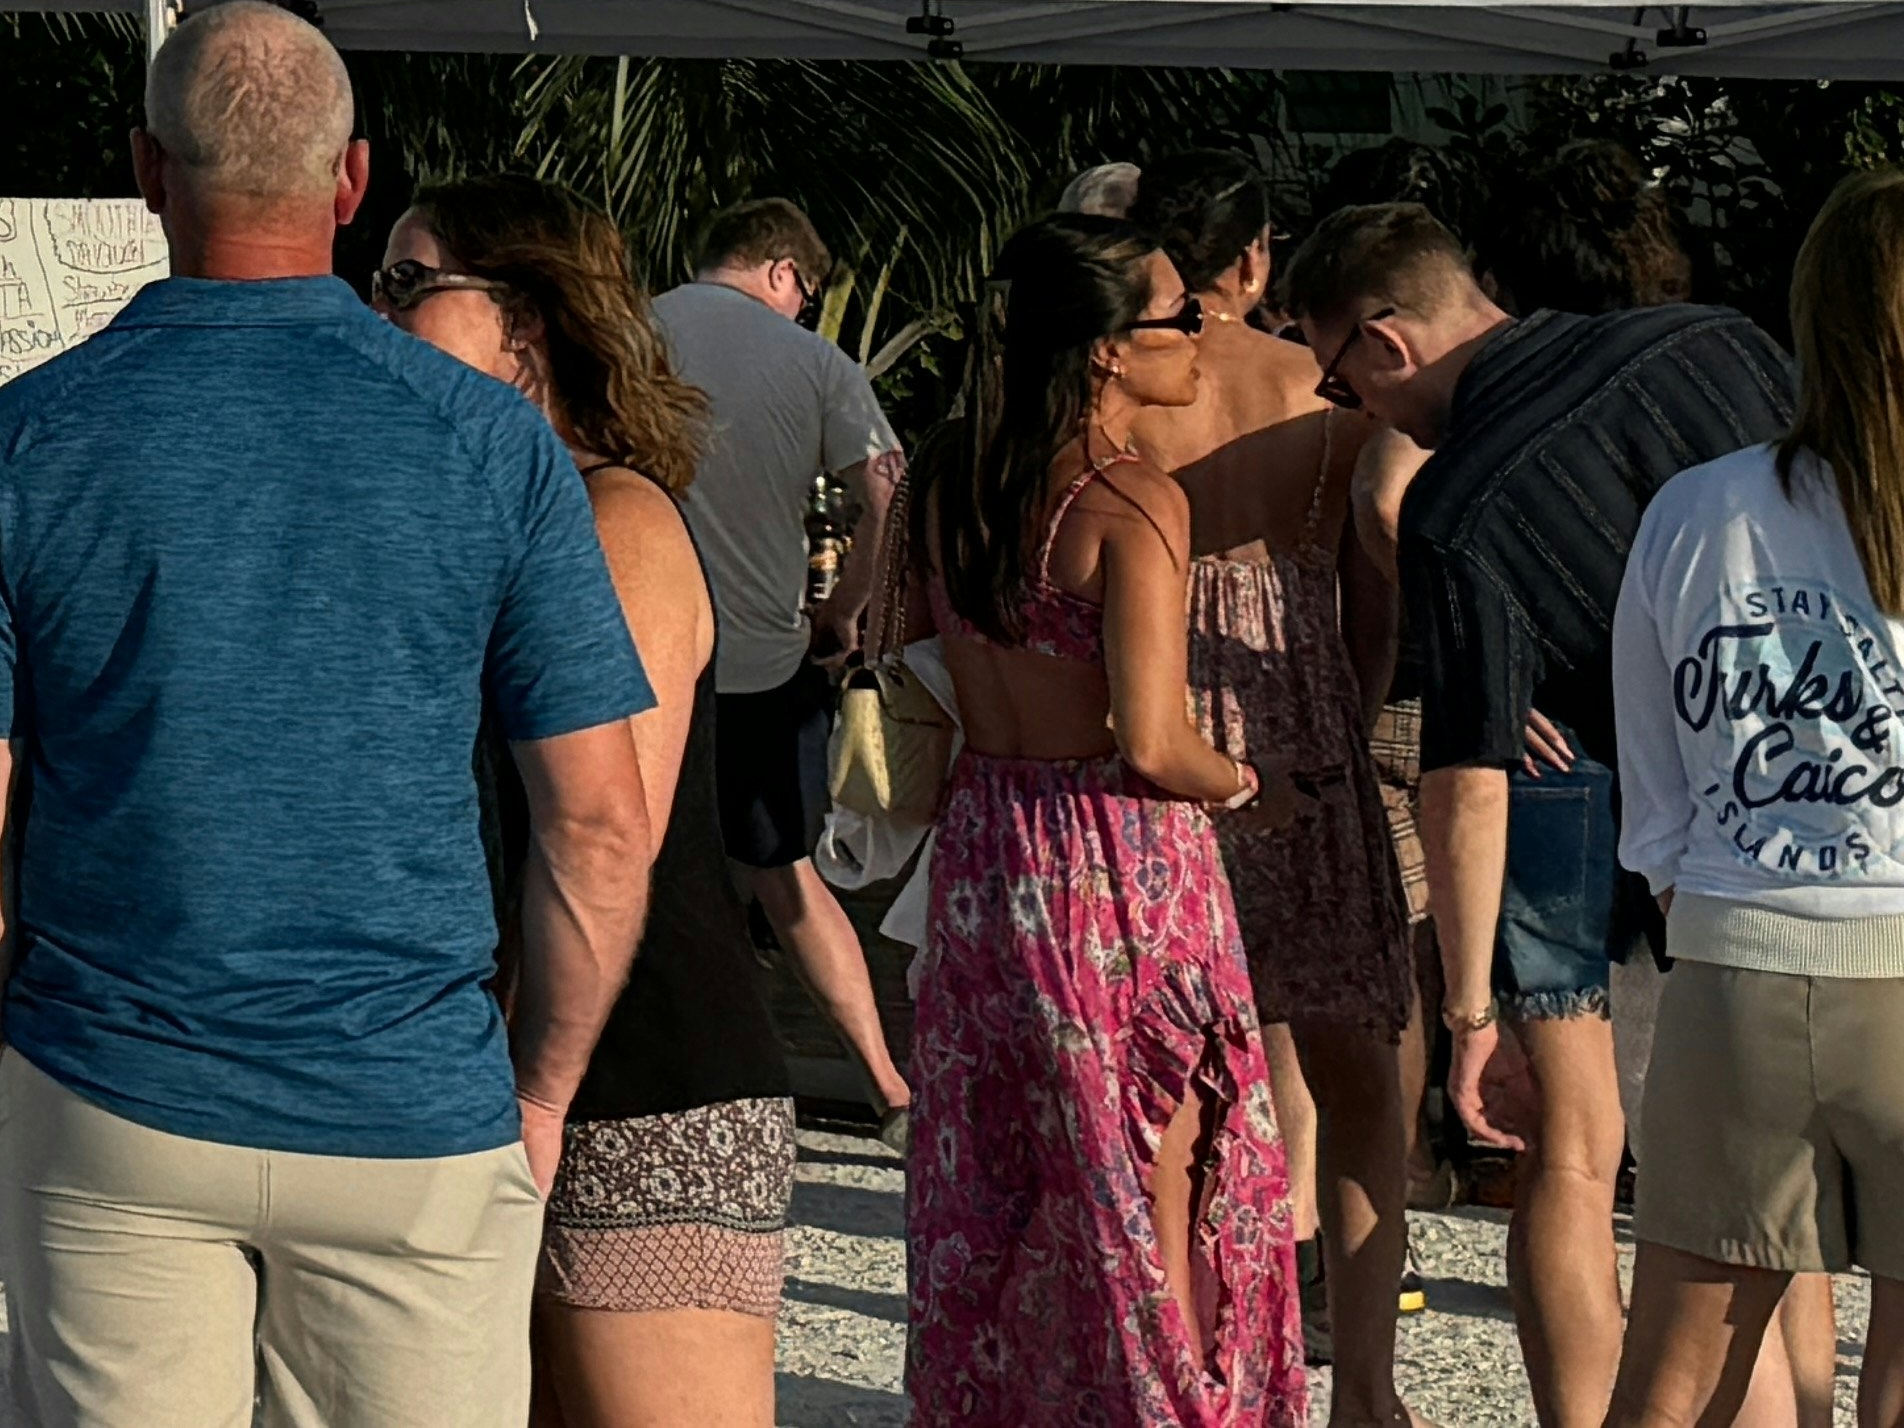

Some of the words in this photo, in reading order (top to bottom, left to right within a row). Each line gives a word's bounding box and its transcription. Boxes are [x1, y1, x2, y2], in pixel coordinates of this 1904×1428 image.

[1746, 586, 1831, 620] STAY
[1674, 622, 1865, 732] Turks
[1851, 703, 1891, 753] &
